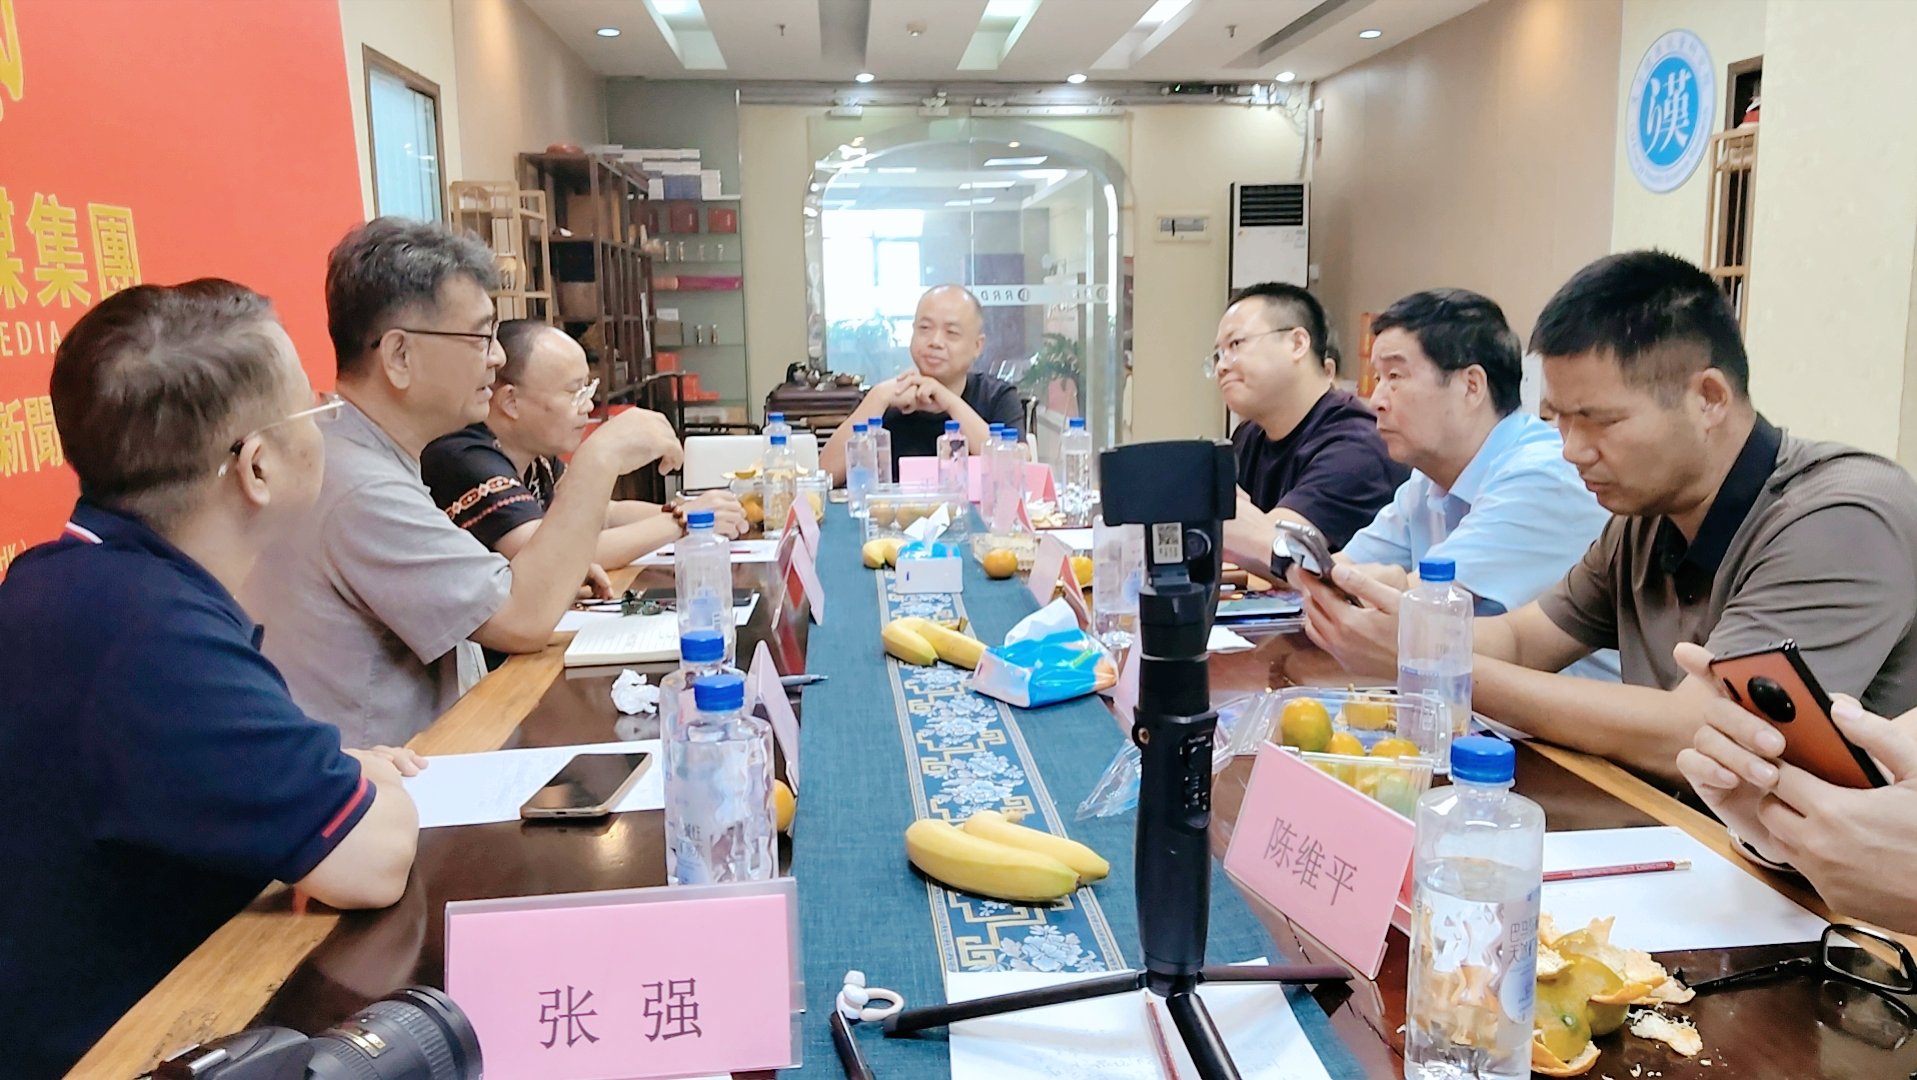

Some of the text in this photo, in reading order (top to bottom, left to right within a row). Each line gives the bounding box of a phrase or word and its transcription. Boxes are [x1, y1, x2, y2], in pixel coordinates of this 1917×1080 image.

[1263, 816, 1357, 906] 陈维平
[537, 977, 703, 1049] 张强
